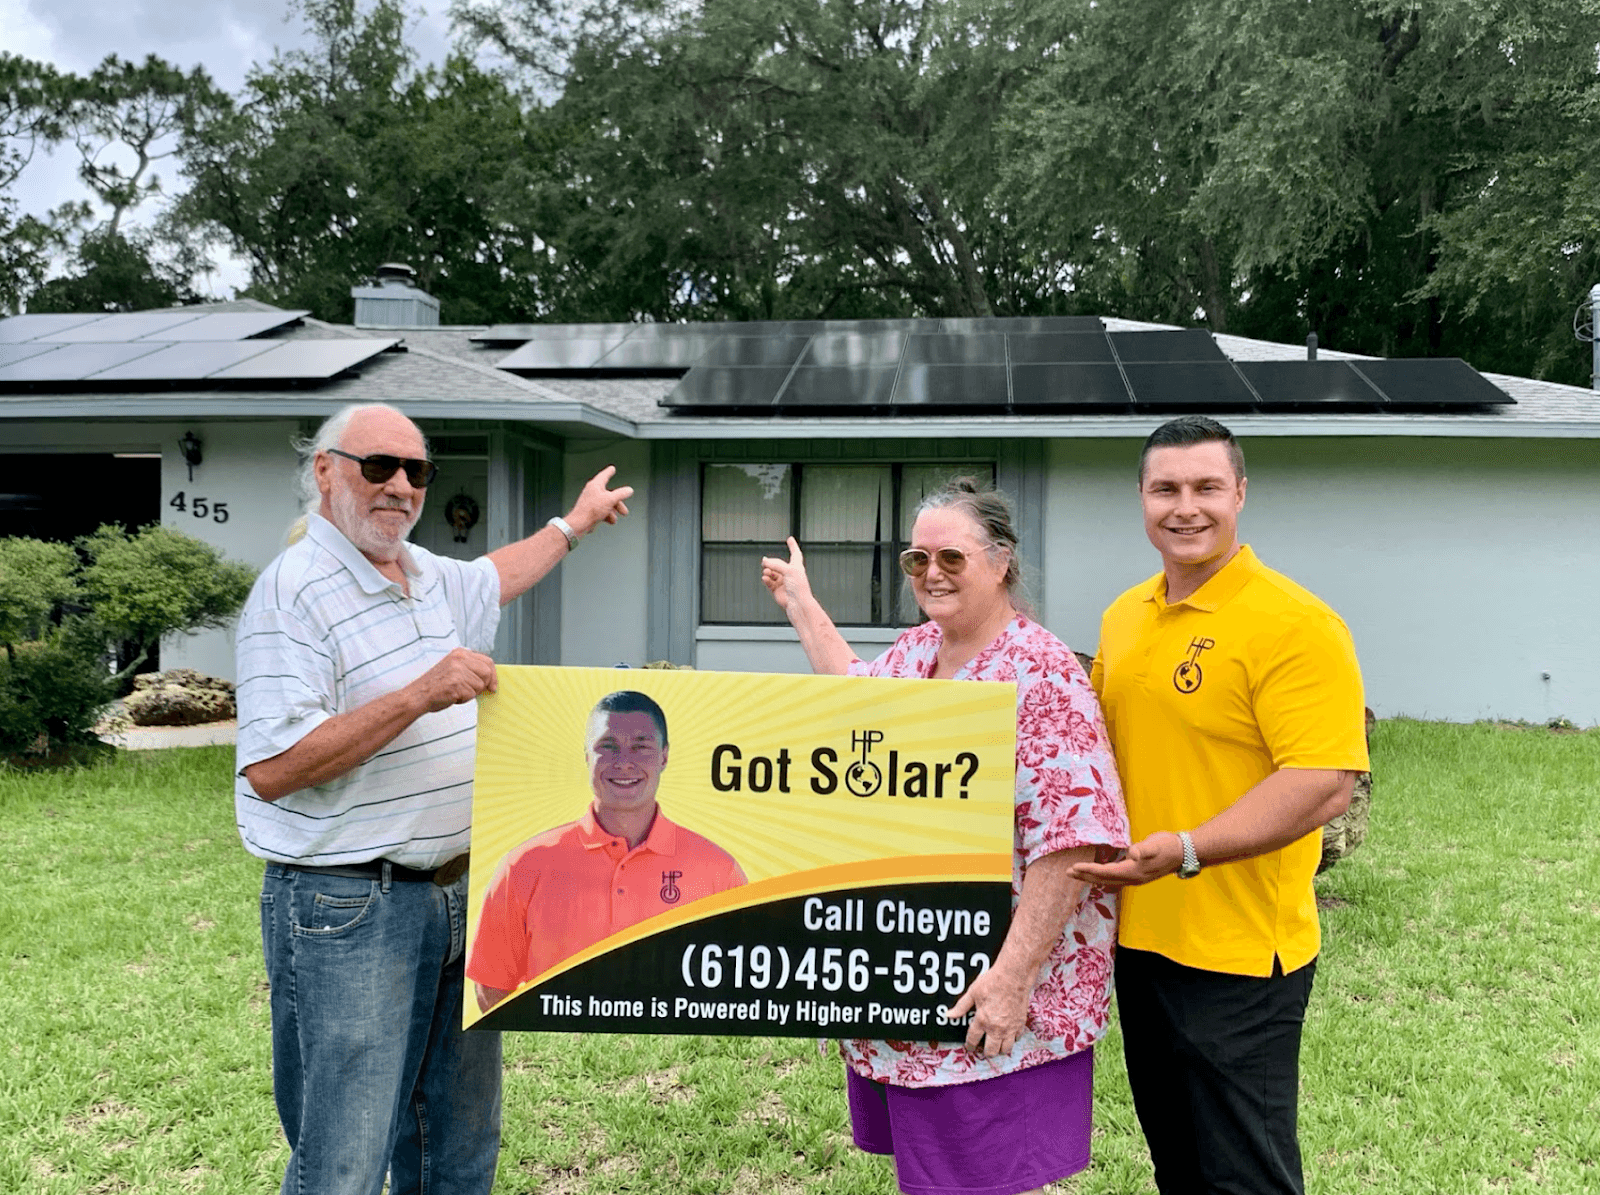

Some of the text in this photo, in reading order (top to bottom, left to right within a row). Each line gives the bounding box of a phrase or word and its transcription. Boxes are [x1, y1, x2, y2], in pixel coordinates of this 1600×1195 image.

[170, 491, 229, 524] 455
[711, 743, 792, 794] Got
[803, 897, 991, 942] Call Cheyne
[539, 994, 583, 1017] This
[588, 995, 644, 1018] home
[650, 996, 669, 1018] is
[674, 997, 761, 1021] Powered
[766, 999, 791, 1026] by
[795, 1000, 863, 1027] Higher
[868, 1002, 931, 1026] Power
